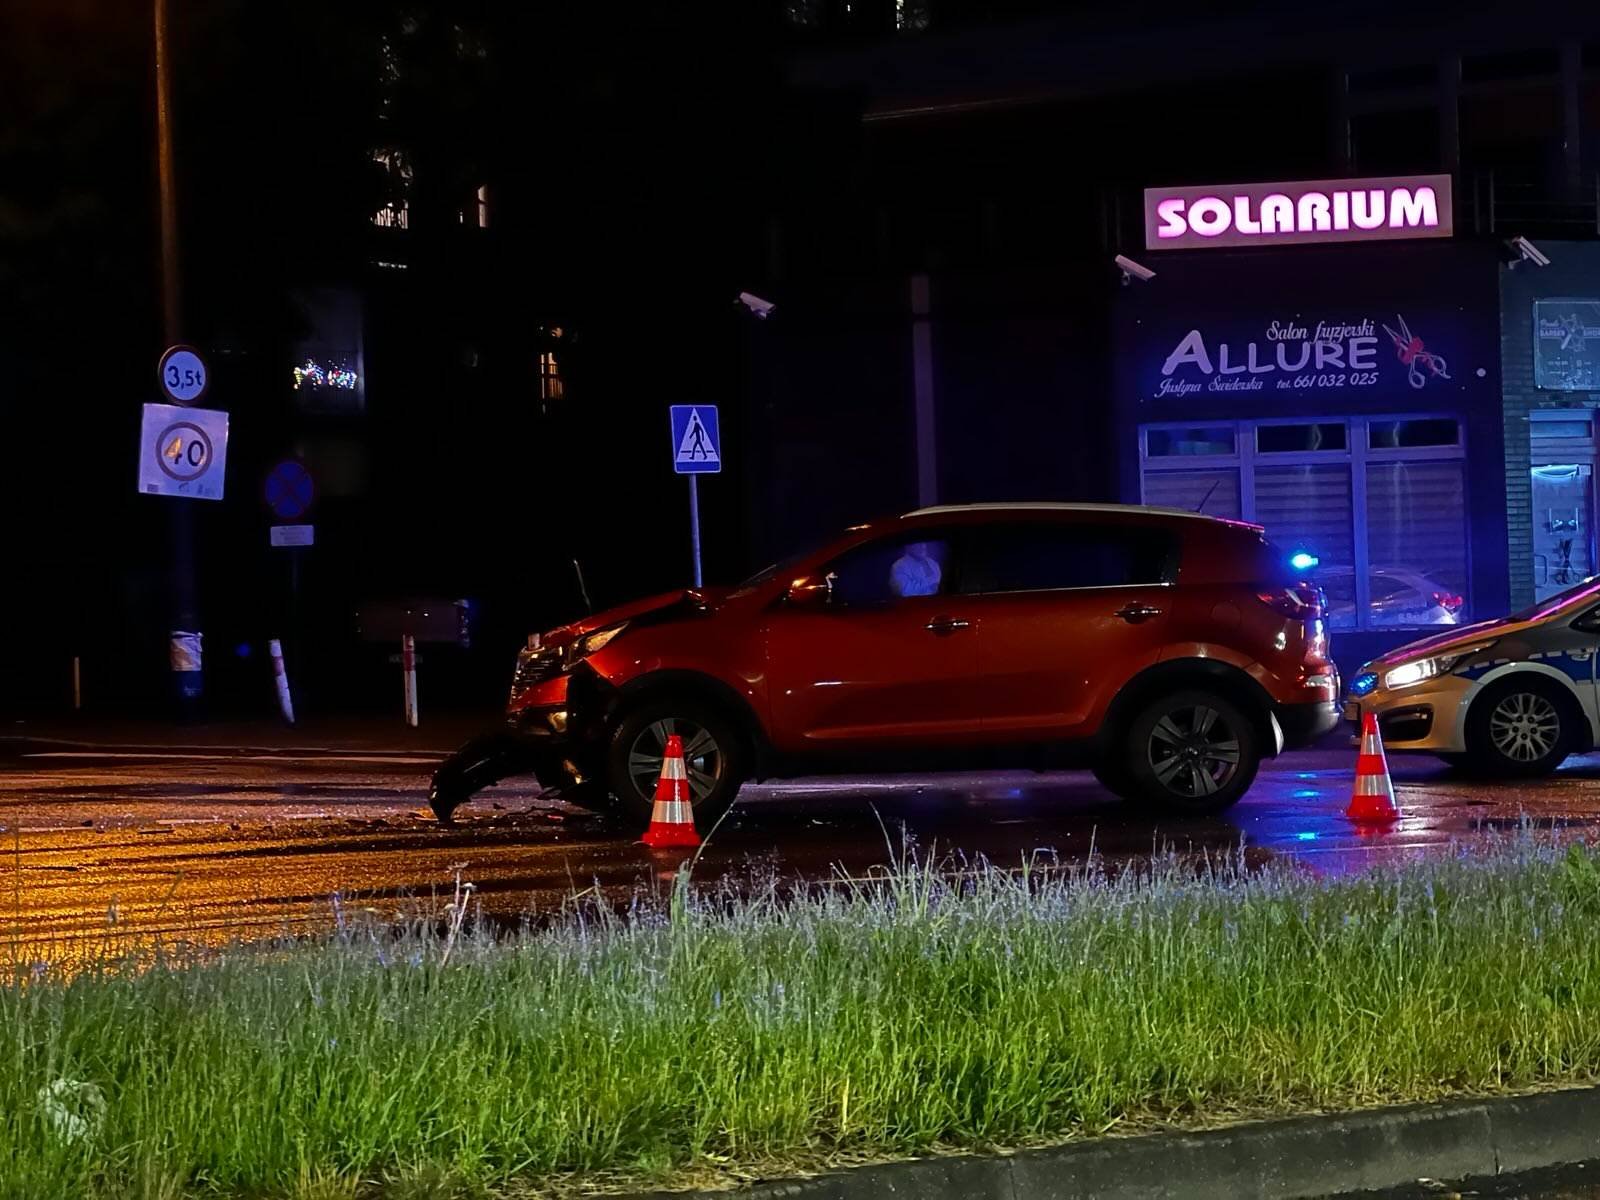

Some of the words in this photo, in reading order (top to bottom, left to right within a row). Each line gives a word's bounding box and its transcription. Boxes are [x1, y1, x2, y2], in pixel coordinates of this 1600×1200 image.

[1157, 188, 1439, 238] SOLARIUM
[1266, 320, 1308, 341] Salon
[1161, 329, 1378, 375] ALLURE
[167, 365, 203, 389] 3,5t
[1153, 377, 1202, 399] Justyna
[1294, 375, 1317, 388] 661
[1317, 374, 1346, 387] 032
[1350, 372, 1379, 385] 025
[164, 437, 206, 467] 40
